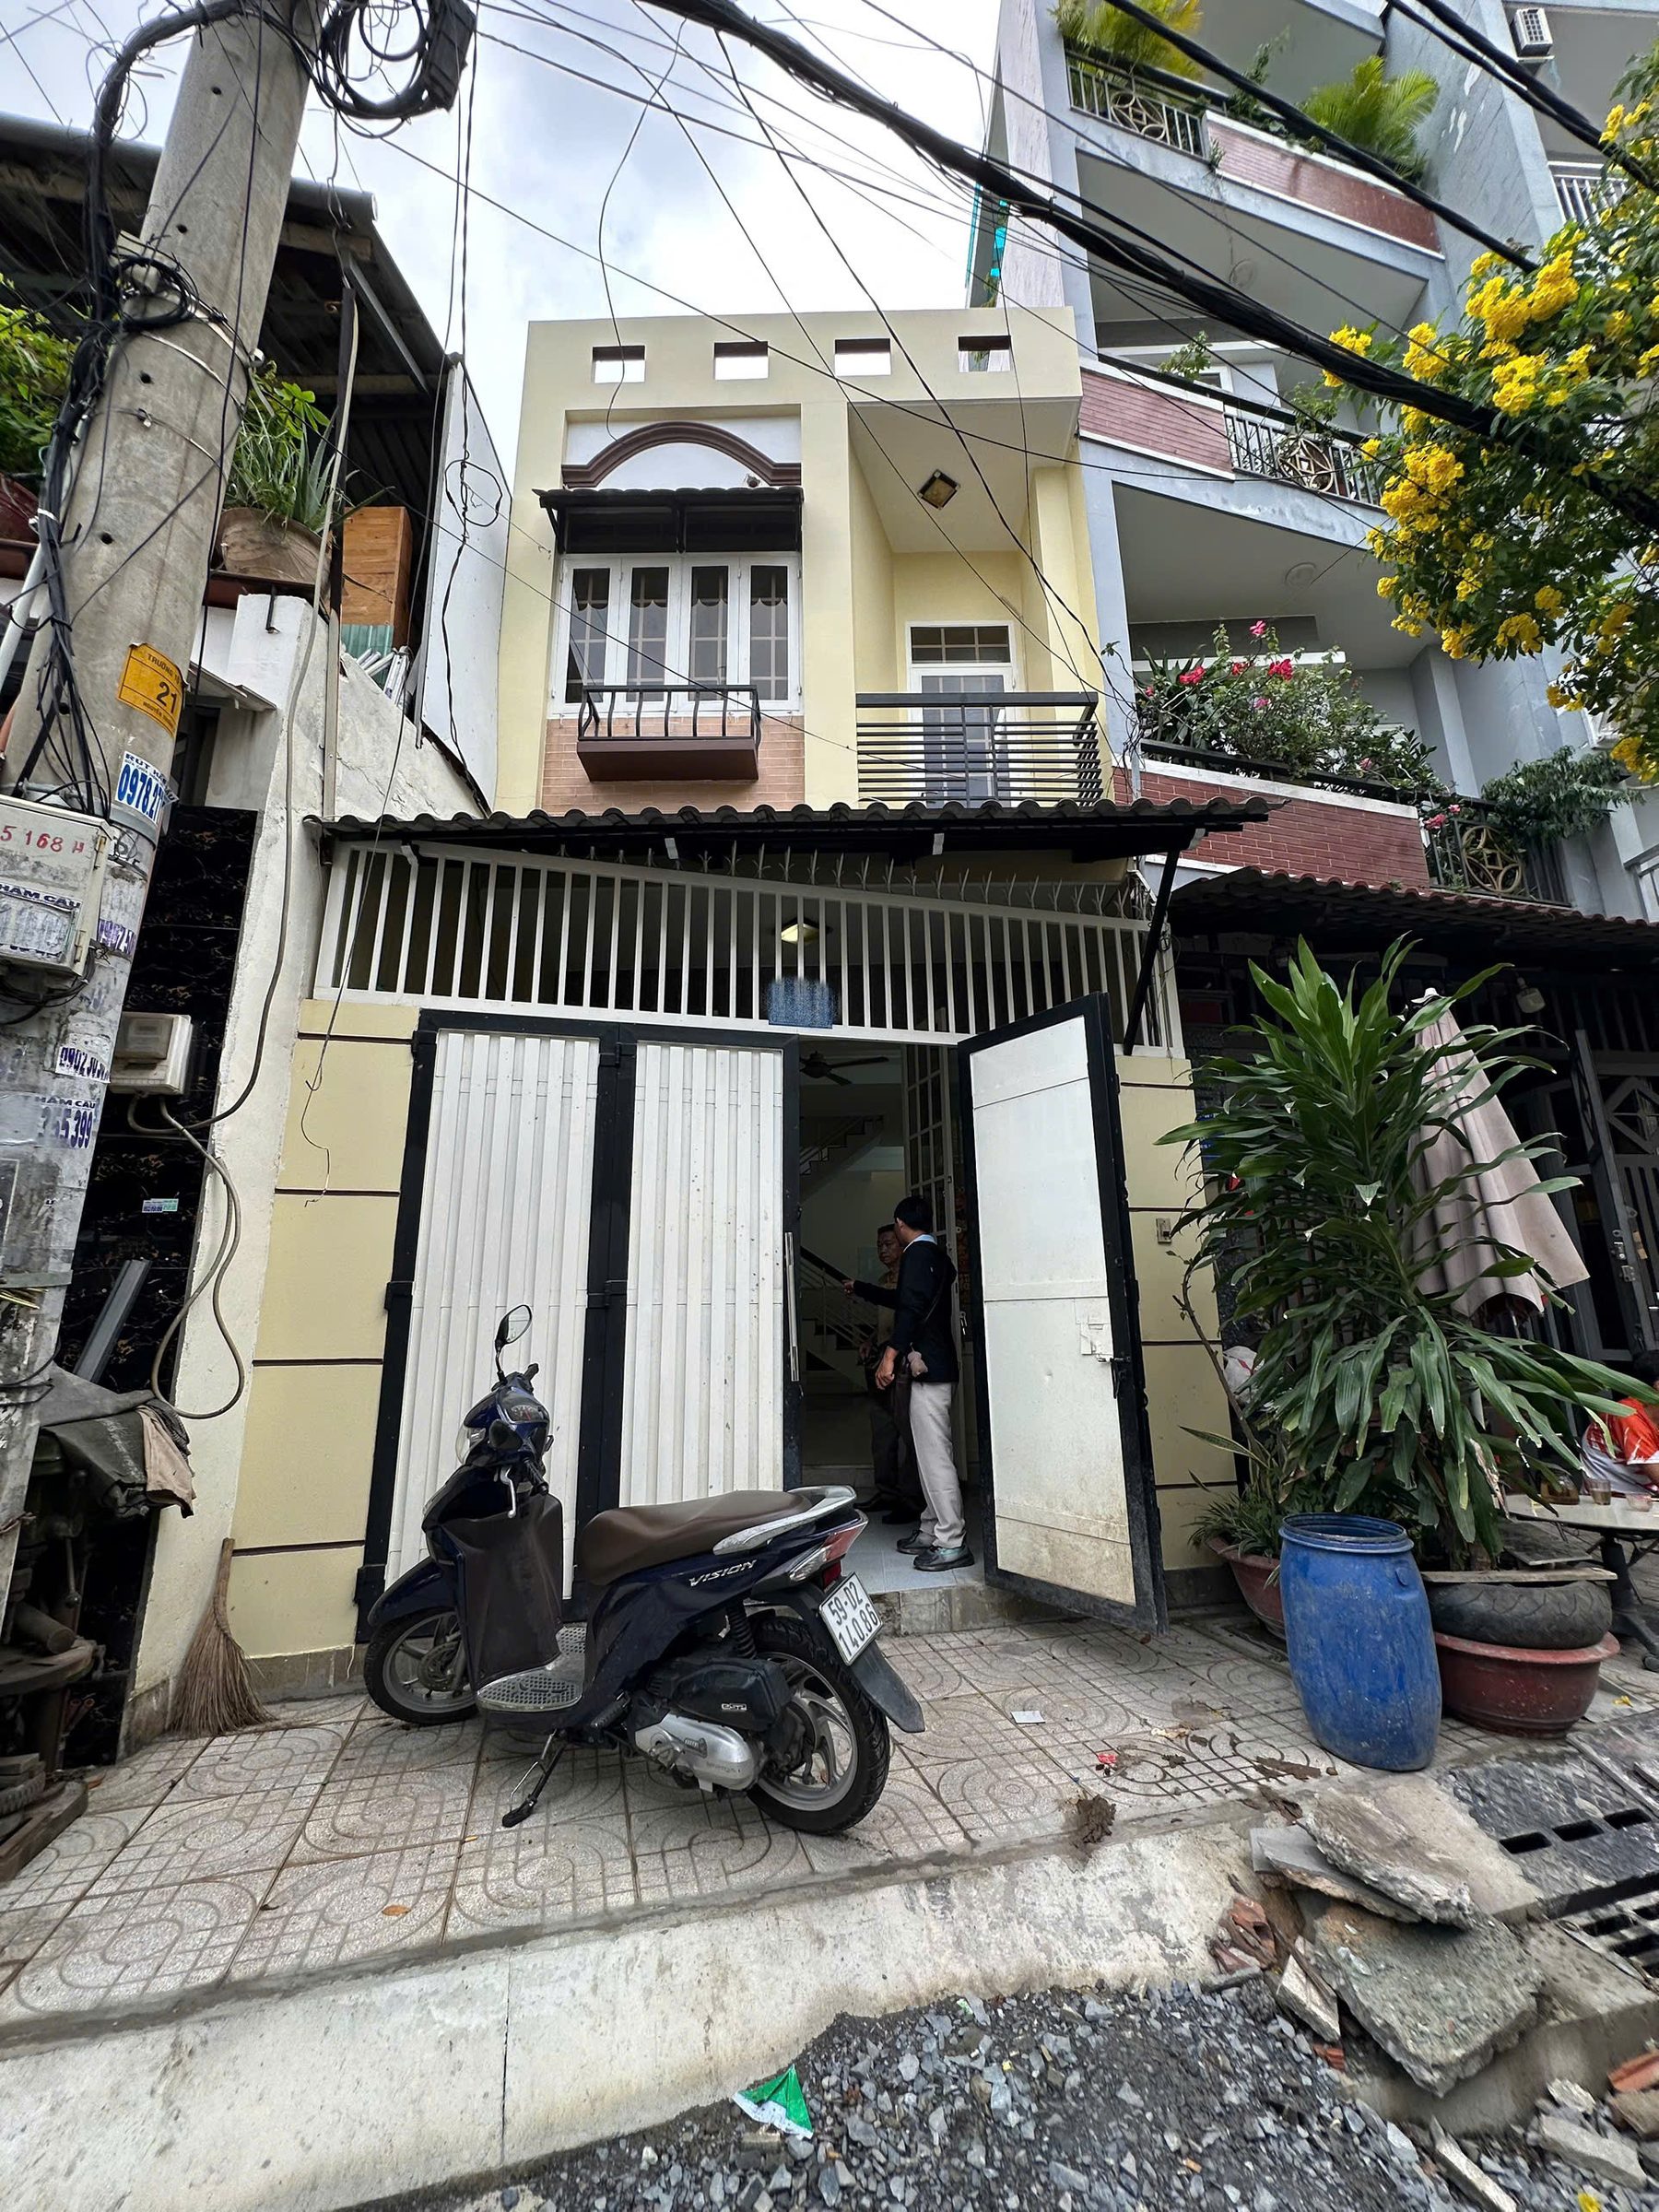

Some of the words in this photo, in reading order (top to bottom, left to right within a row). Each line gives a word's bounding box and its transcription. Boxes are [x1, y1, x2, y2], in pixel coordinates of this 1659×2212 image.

[156, 682, 177, 713] 21
[26, 830, 64, 853] 168
[688, 1559, 757, 1586] VISION
[828, 1581, 863, 1626] 59-D2
[839, 1603, 877, 1656] 140.86
